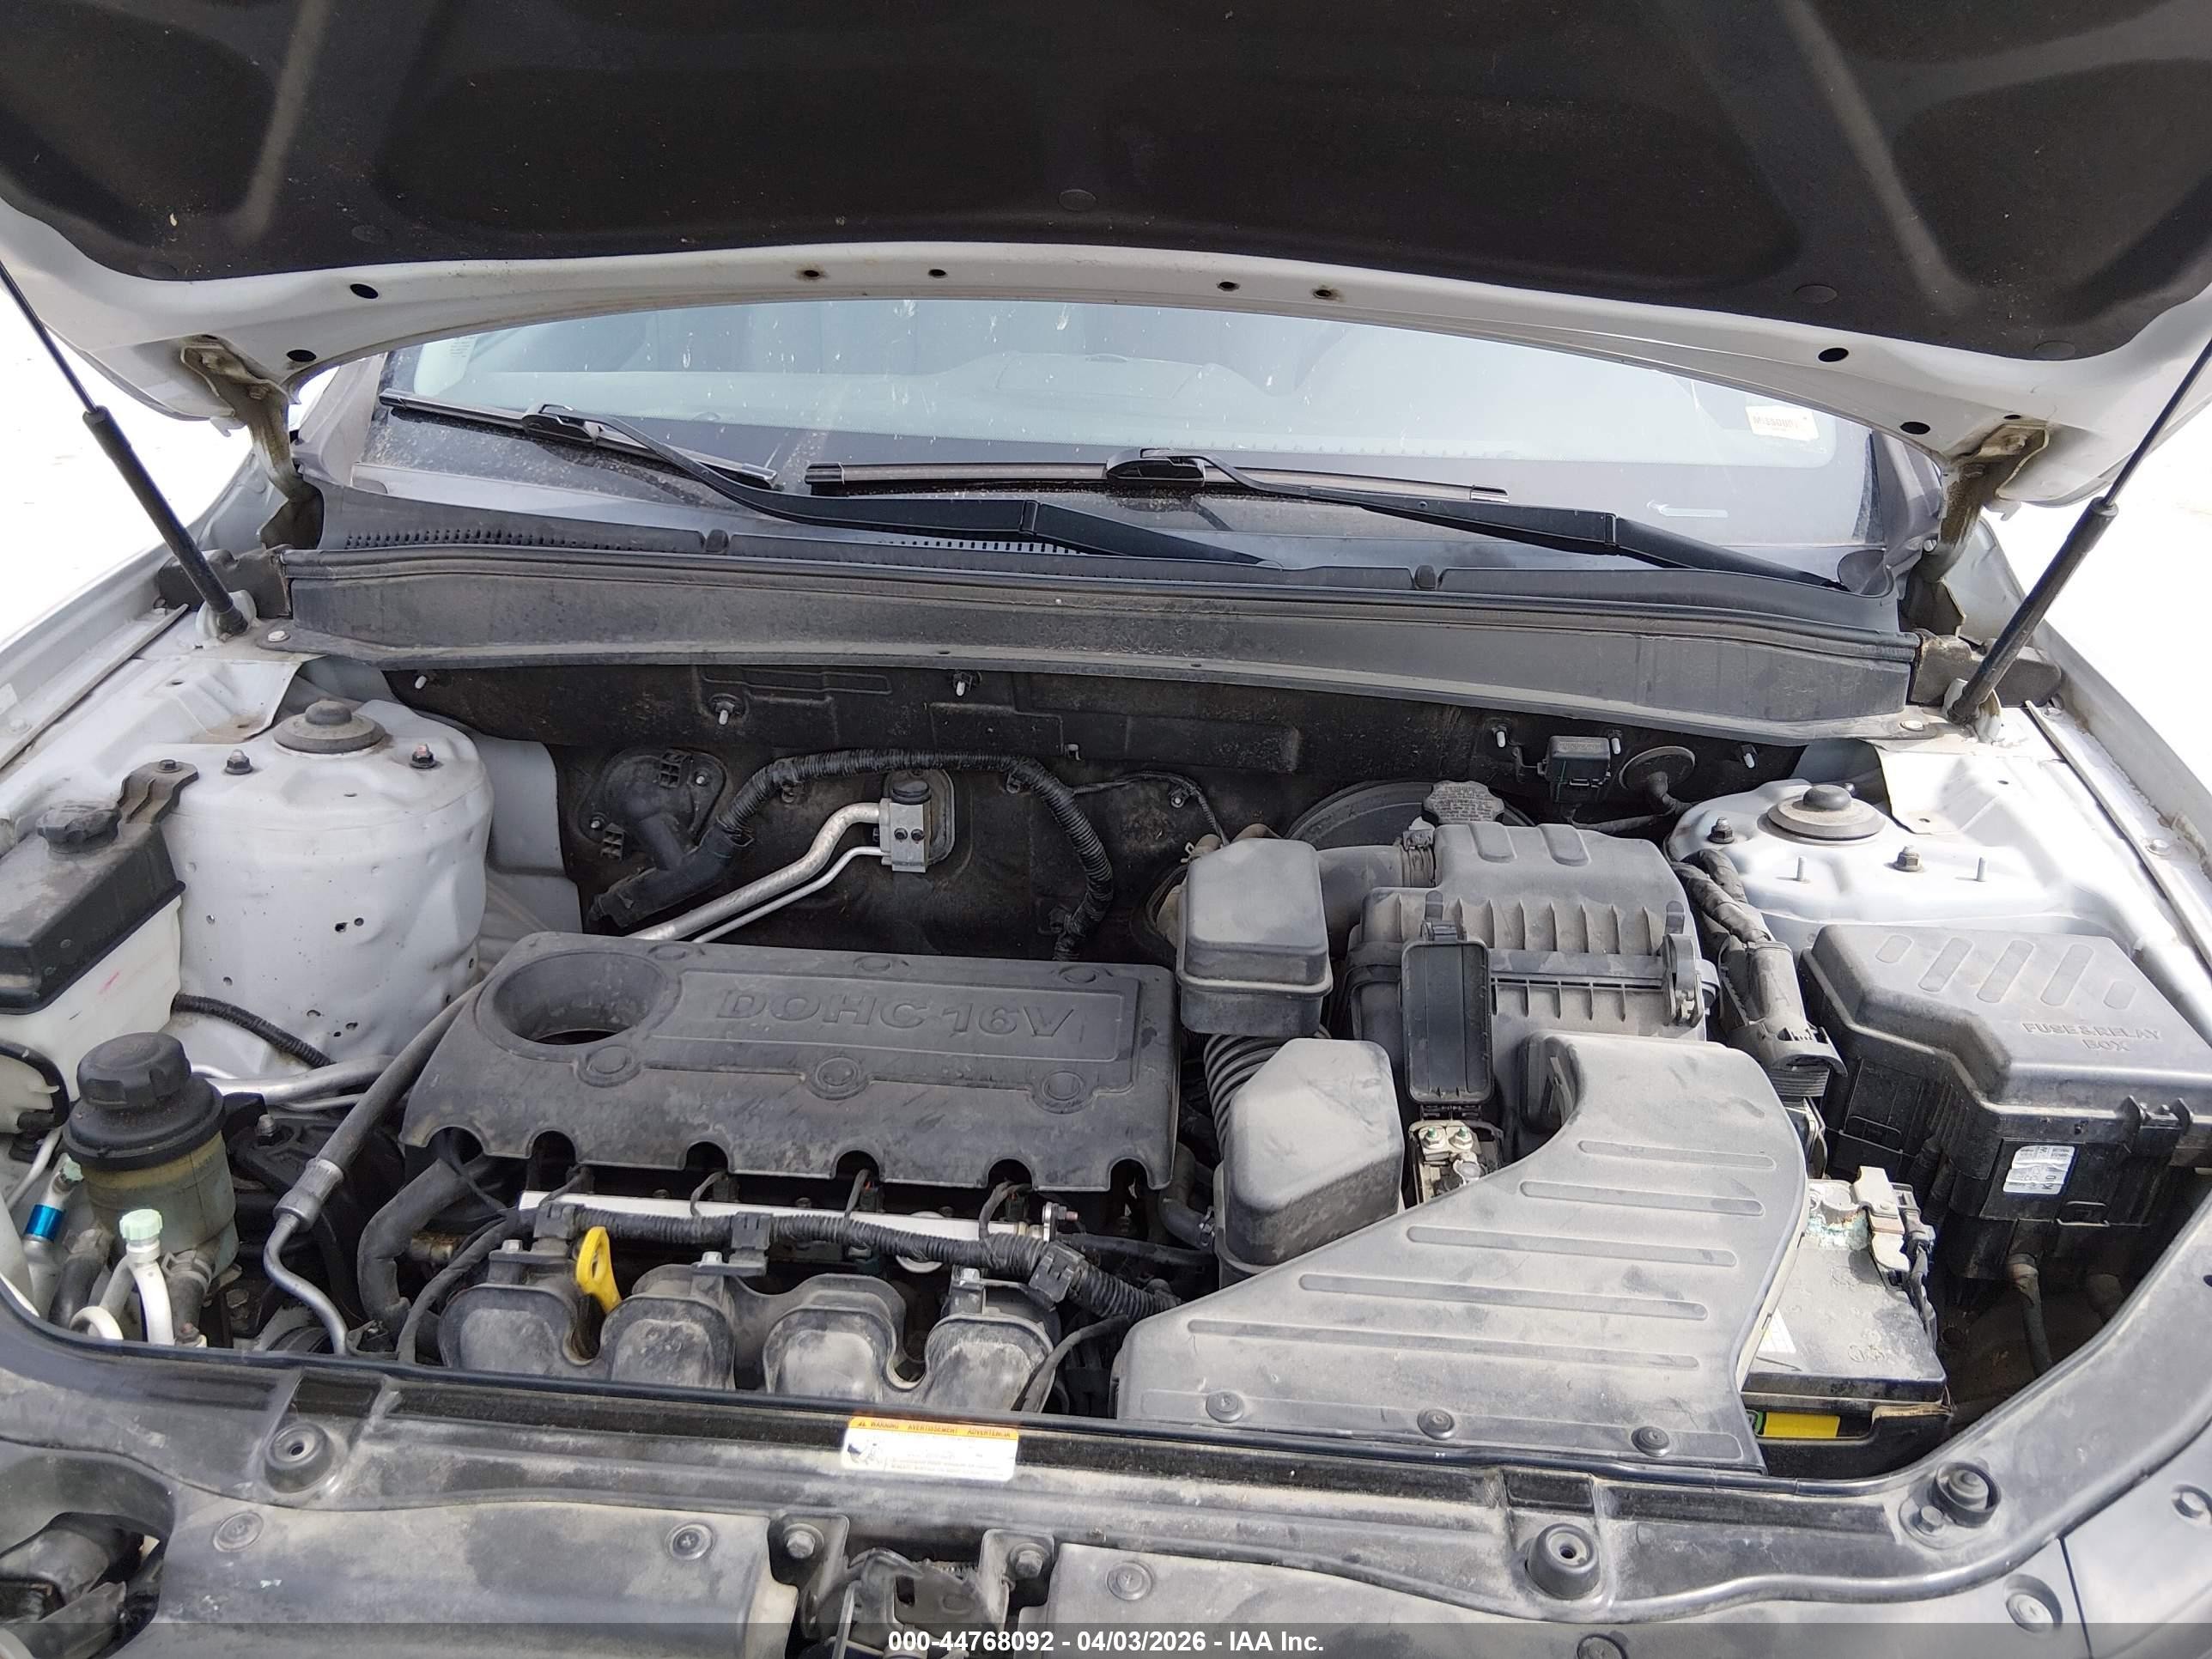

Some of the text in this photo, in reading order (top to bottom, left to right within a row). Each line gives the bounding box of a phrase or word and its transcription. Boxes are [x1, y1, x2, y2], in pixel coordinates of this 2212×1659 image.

[716, 989, 1074, 1037] DOHC 16V
[2081, 1038, 2131, 1052] BOX
